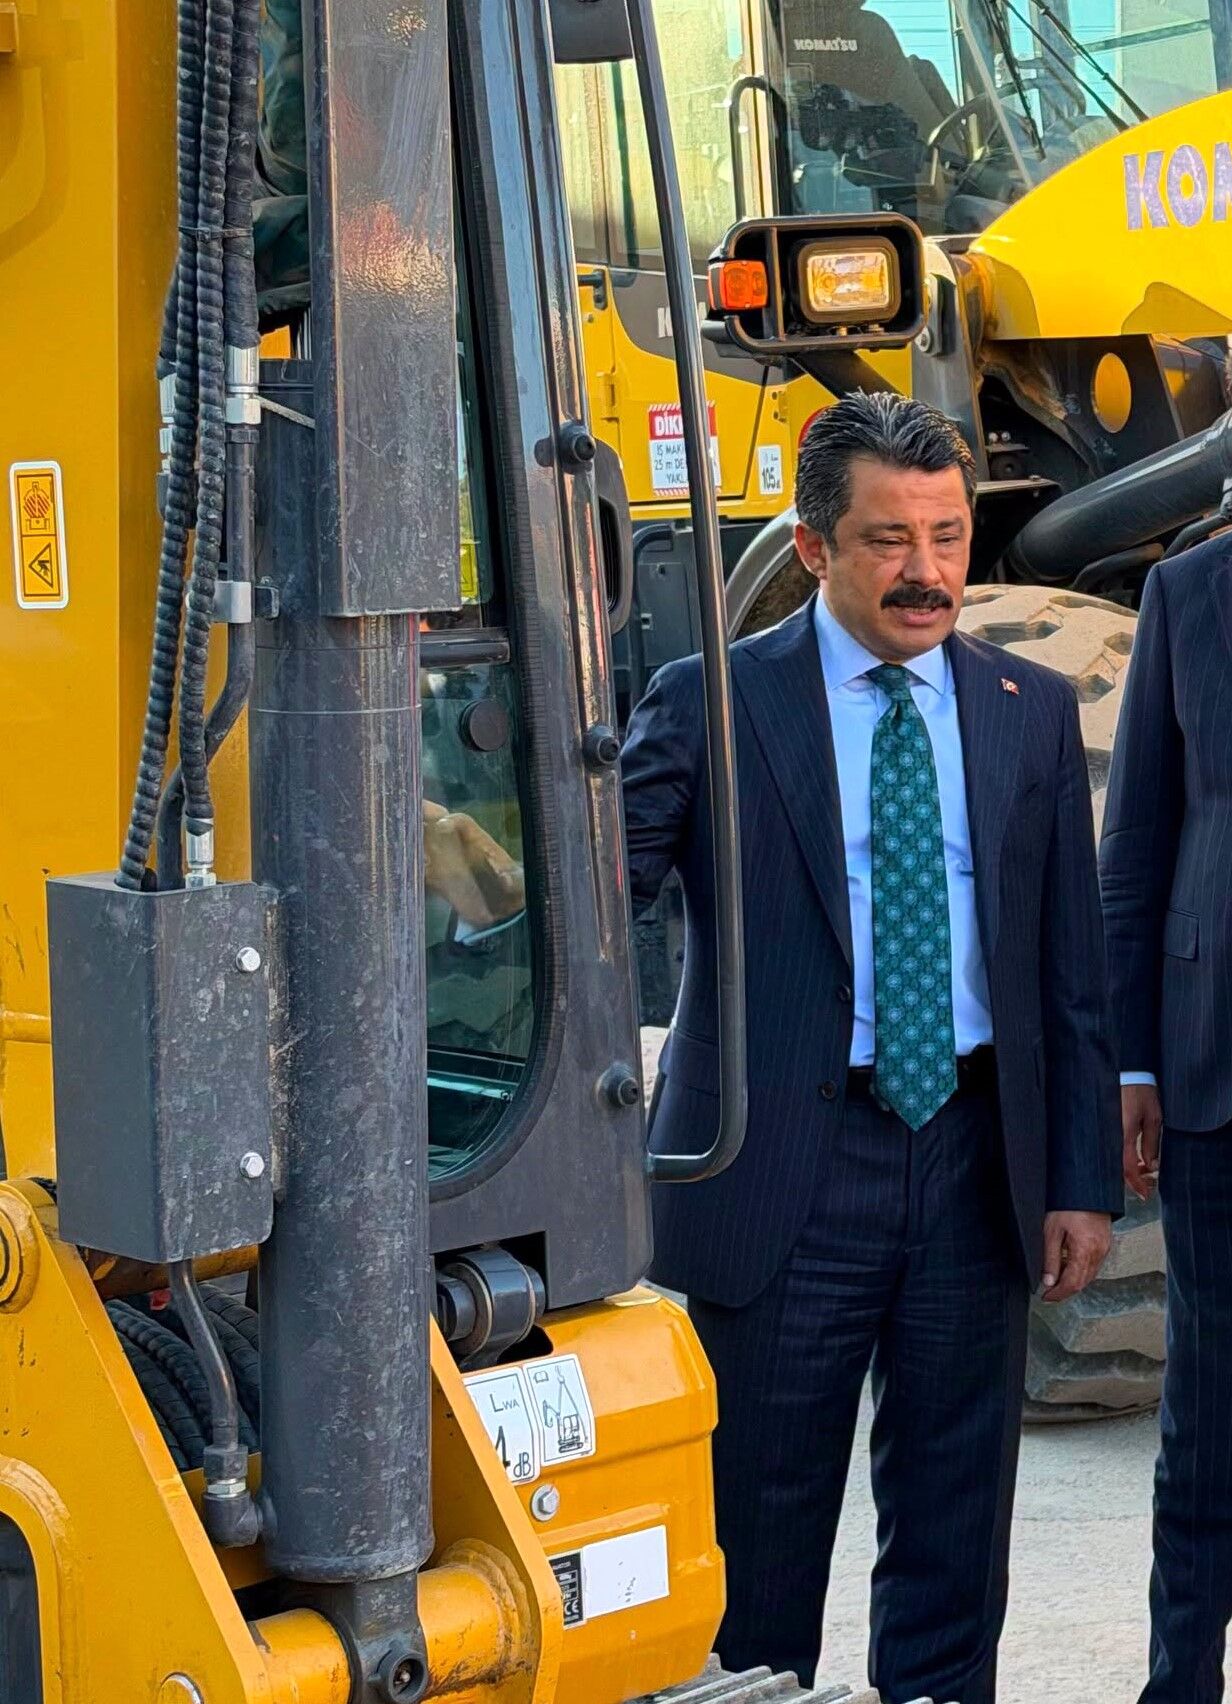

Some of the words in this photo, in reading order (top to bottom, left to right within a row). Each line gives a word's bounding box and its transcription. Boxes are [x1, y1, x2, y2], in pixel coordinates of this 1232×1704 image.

[793, 36, 858, 52] KOMATSU
[654, 459, 664, 471] 25
[674, 458, 686, 470] DE
[666, 473, 687, 485] YAKL
[513, 1452, 532, 1478] dB
